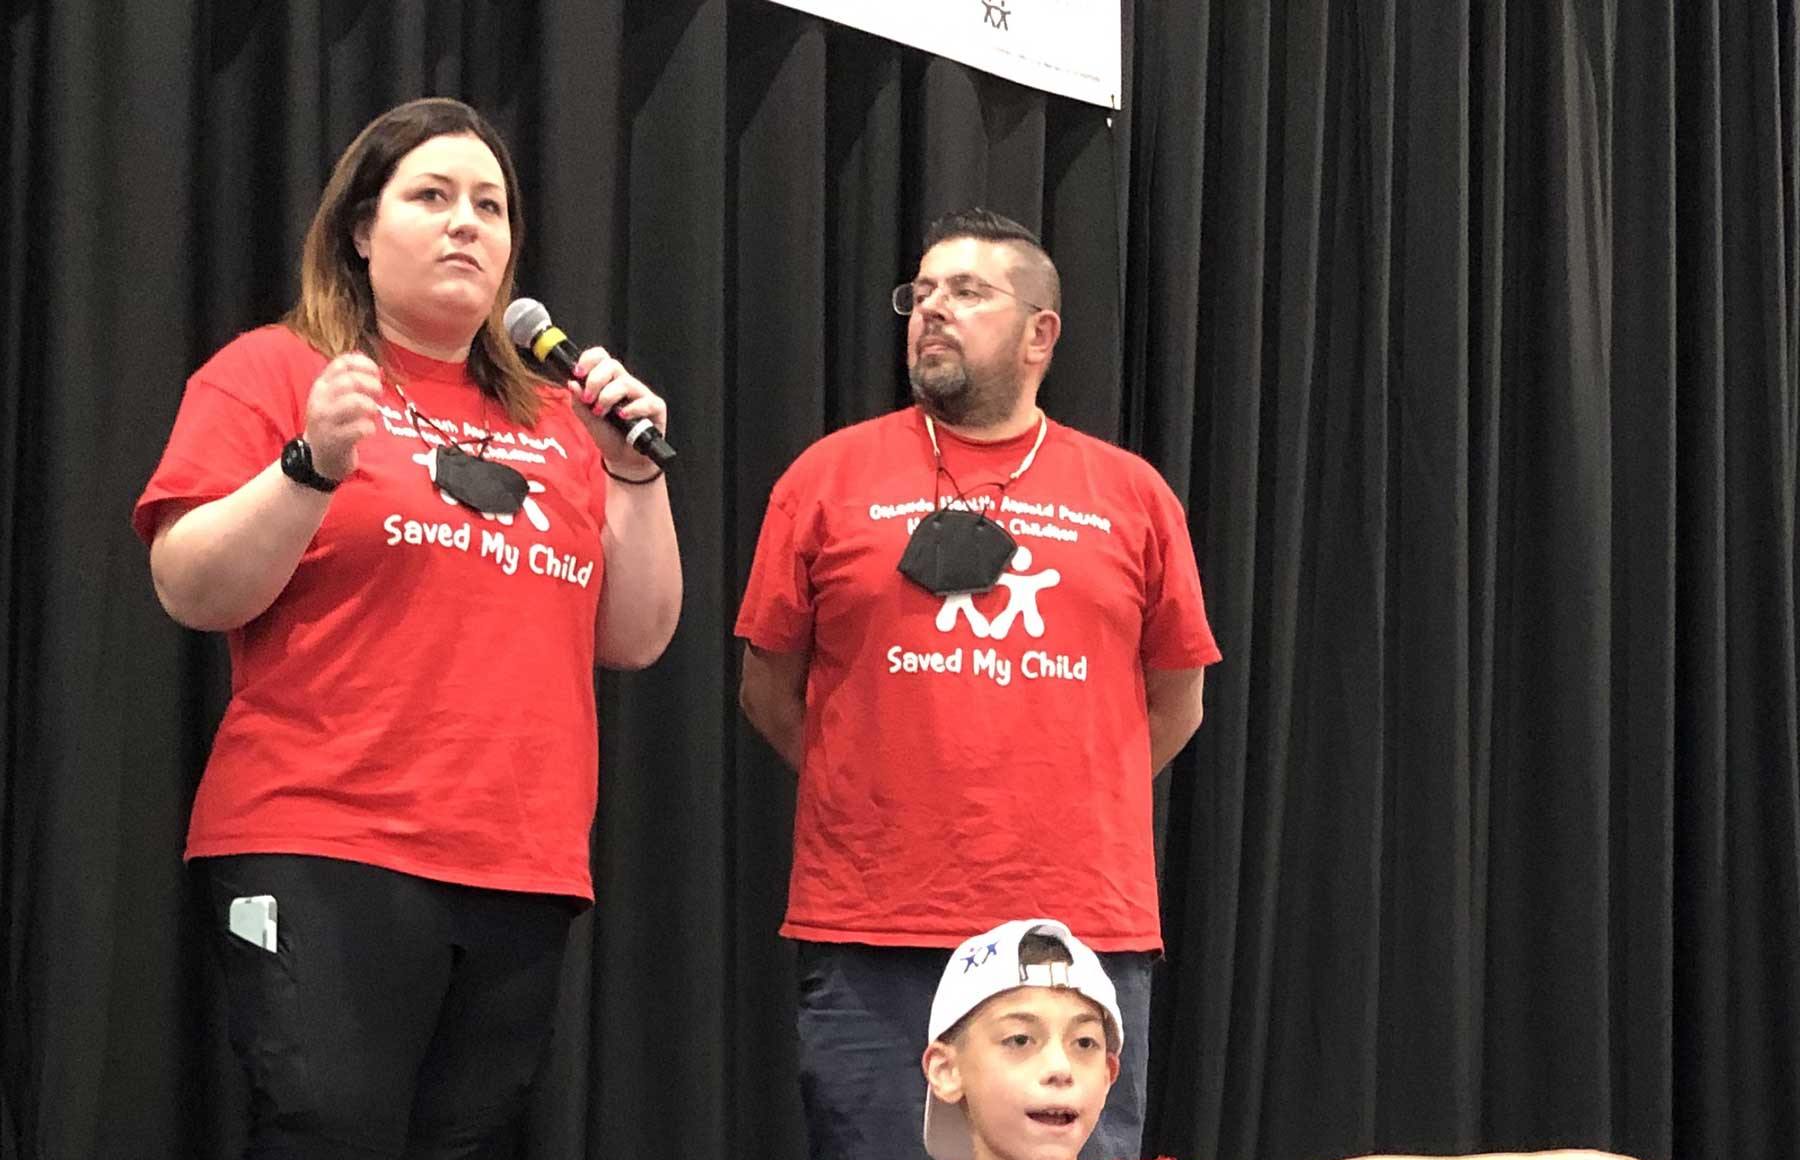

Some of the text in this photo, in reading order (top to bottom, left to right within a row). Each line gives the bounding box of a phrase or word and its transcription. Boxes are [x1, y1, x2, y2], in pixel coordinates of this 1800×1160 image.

[383, 514, 594, 588] Saved My Child
[887, 645, 1088, 686] Saved My Child
